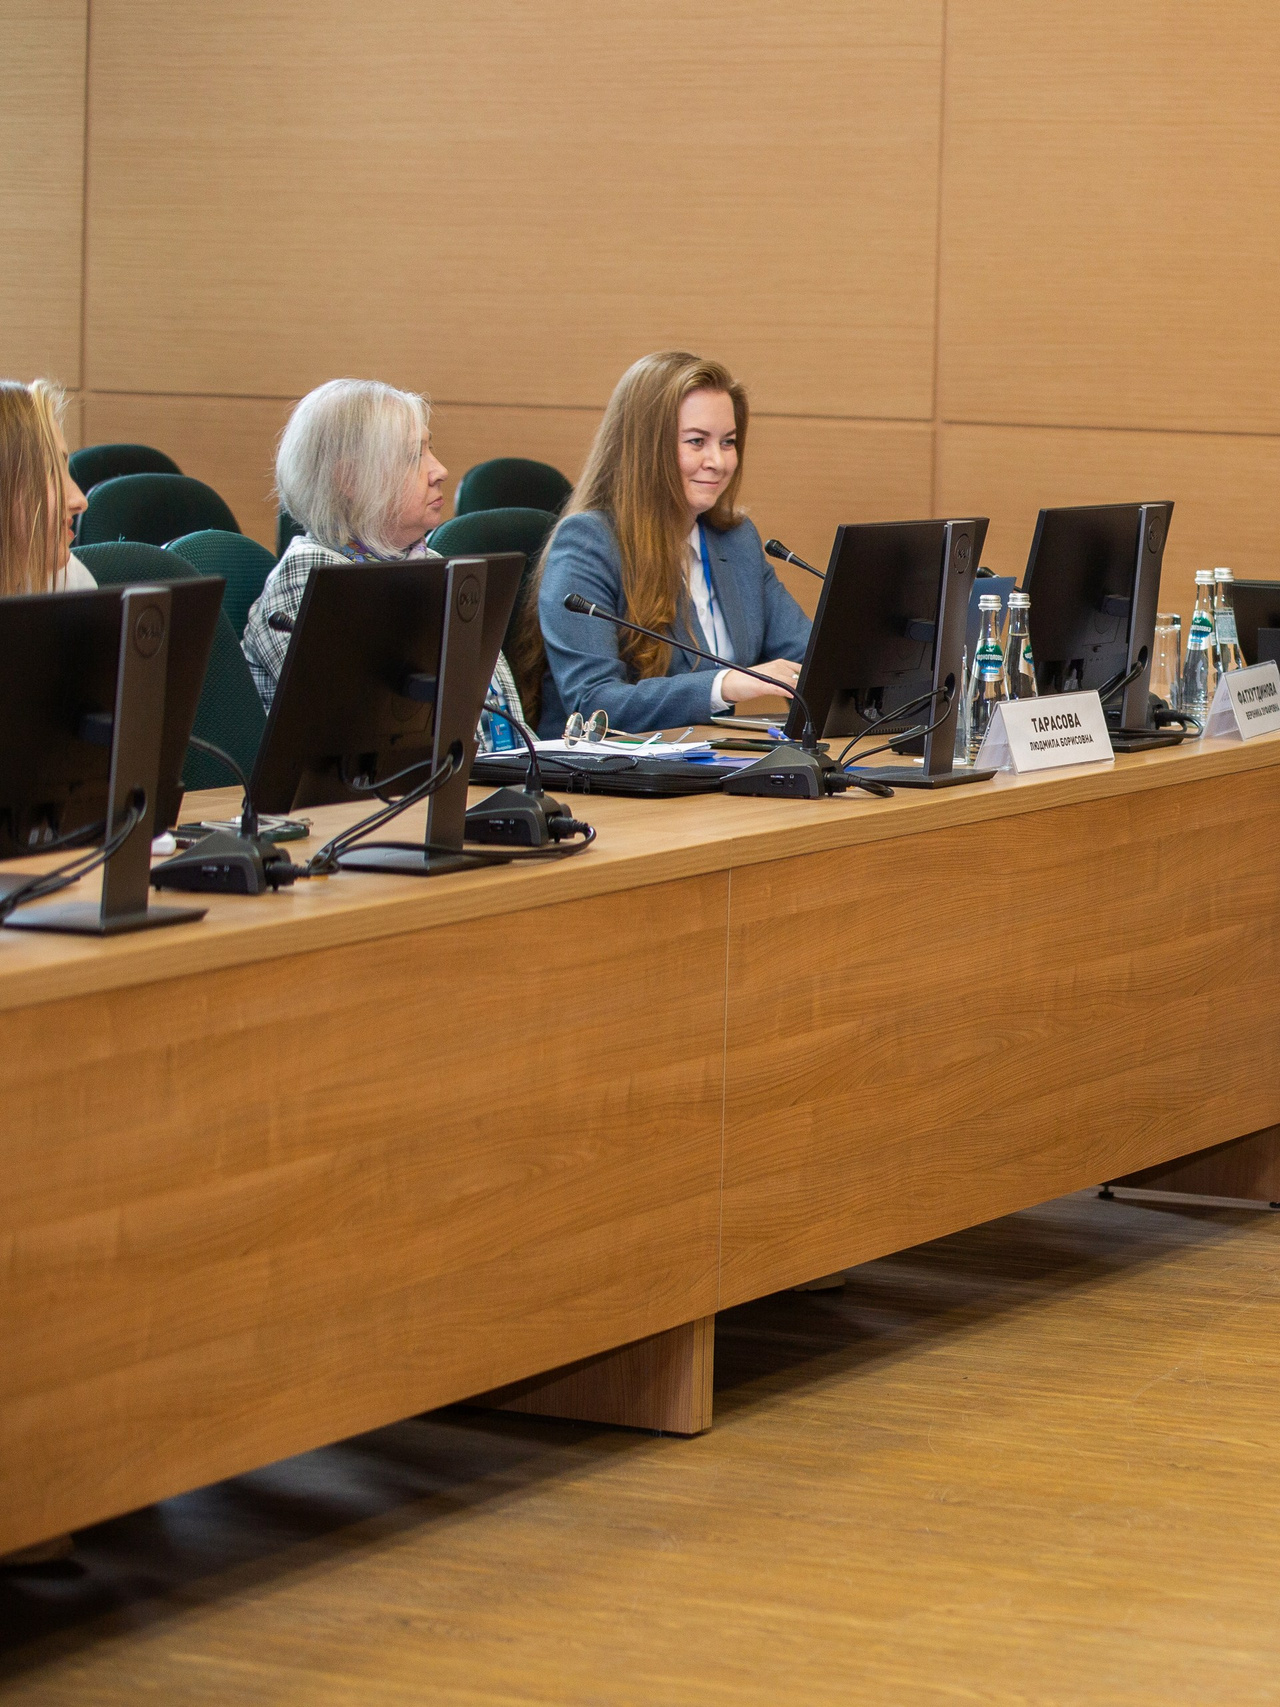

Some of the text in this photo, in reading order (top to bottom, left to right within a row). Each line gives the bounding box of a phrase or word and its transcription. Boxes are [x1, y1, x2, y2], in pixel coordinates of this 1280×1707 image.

[1237, 682, 1277, 704] ФАТХУТДИНОВА
[1031, 712, 1082, 733] ТАРАСОВА
[1029, 734, 1094, 751] ЛЮДМИЛА БОРИСОВНА
